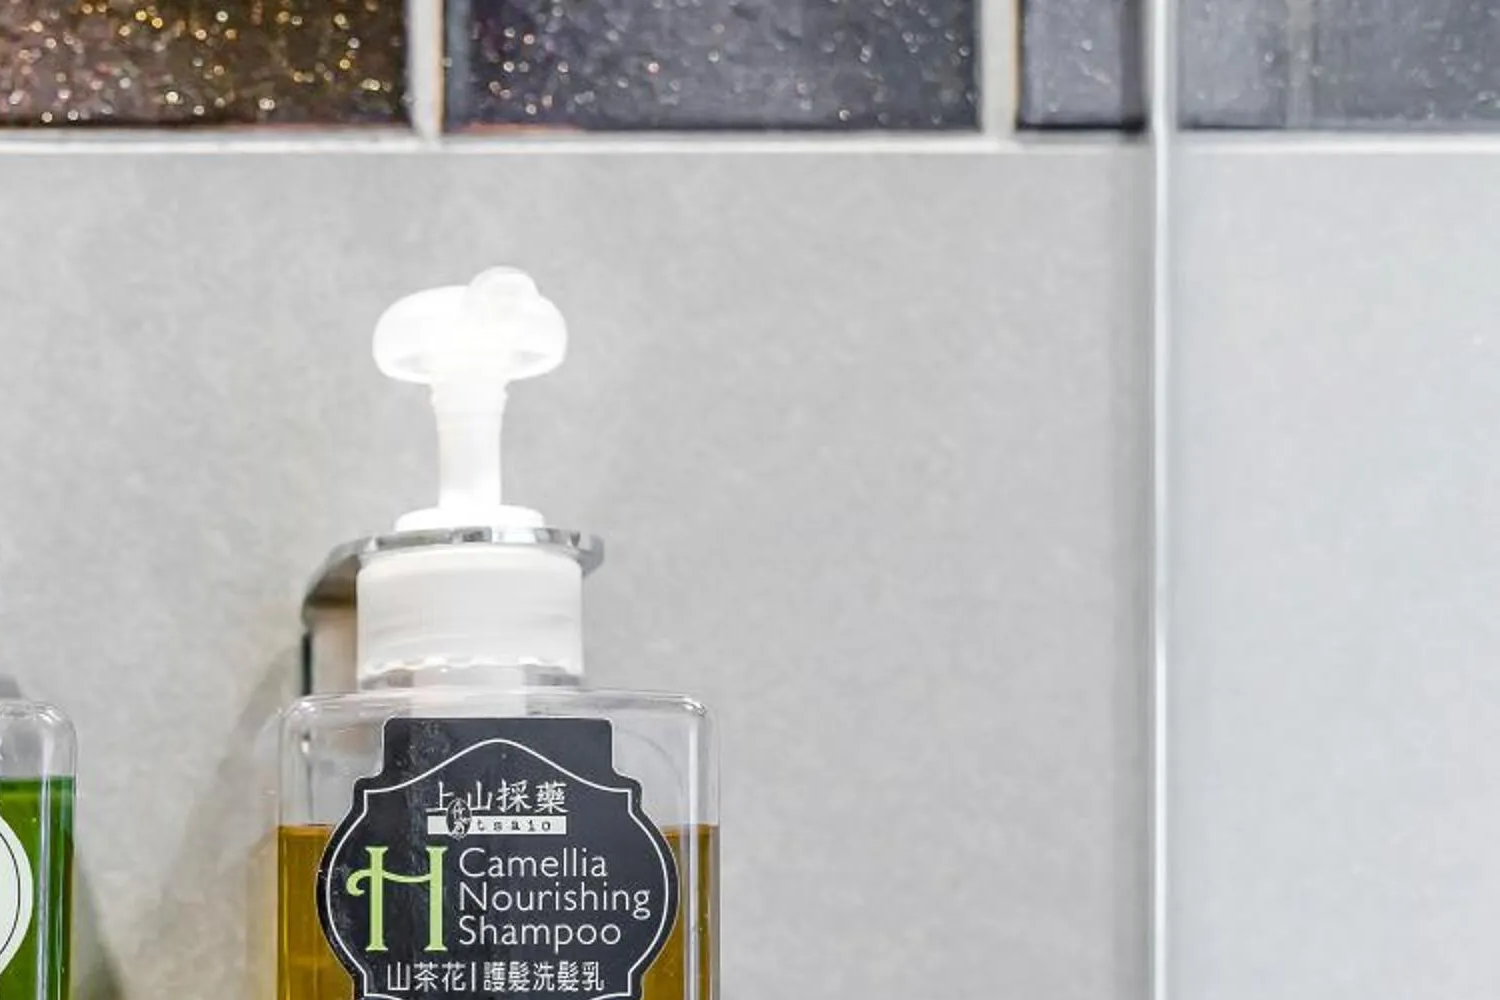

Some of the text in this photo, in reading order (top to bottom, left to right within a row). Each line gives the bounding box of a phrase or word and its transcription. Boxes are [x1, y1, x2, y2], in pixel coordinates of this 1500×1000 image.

[425, 778, 569, 813] 上山採藥
[458, 847, 607, 878] Camellia
[458, 882, 650, 920] Nourishing
[458, 916, 621, 954] Shampoo
